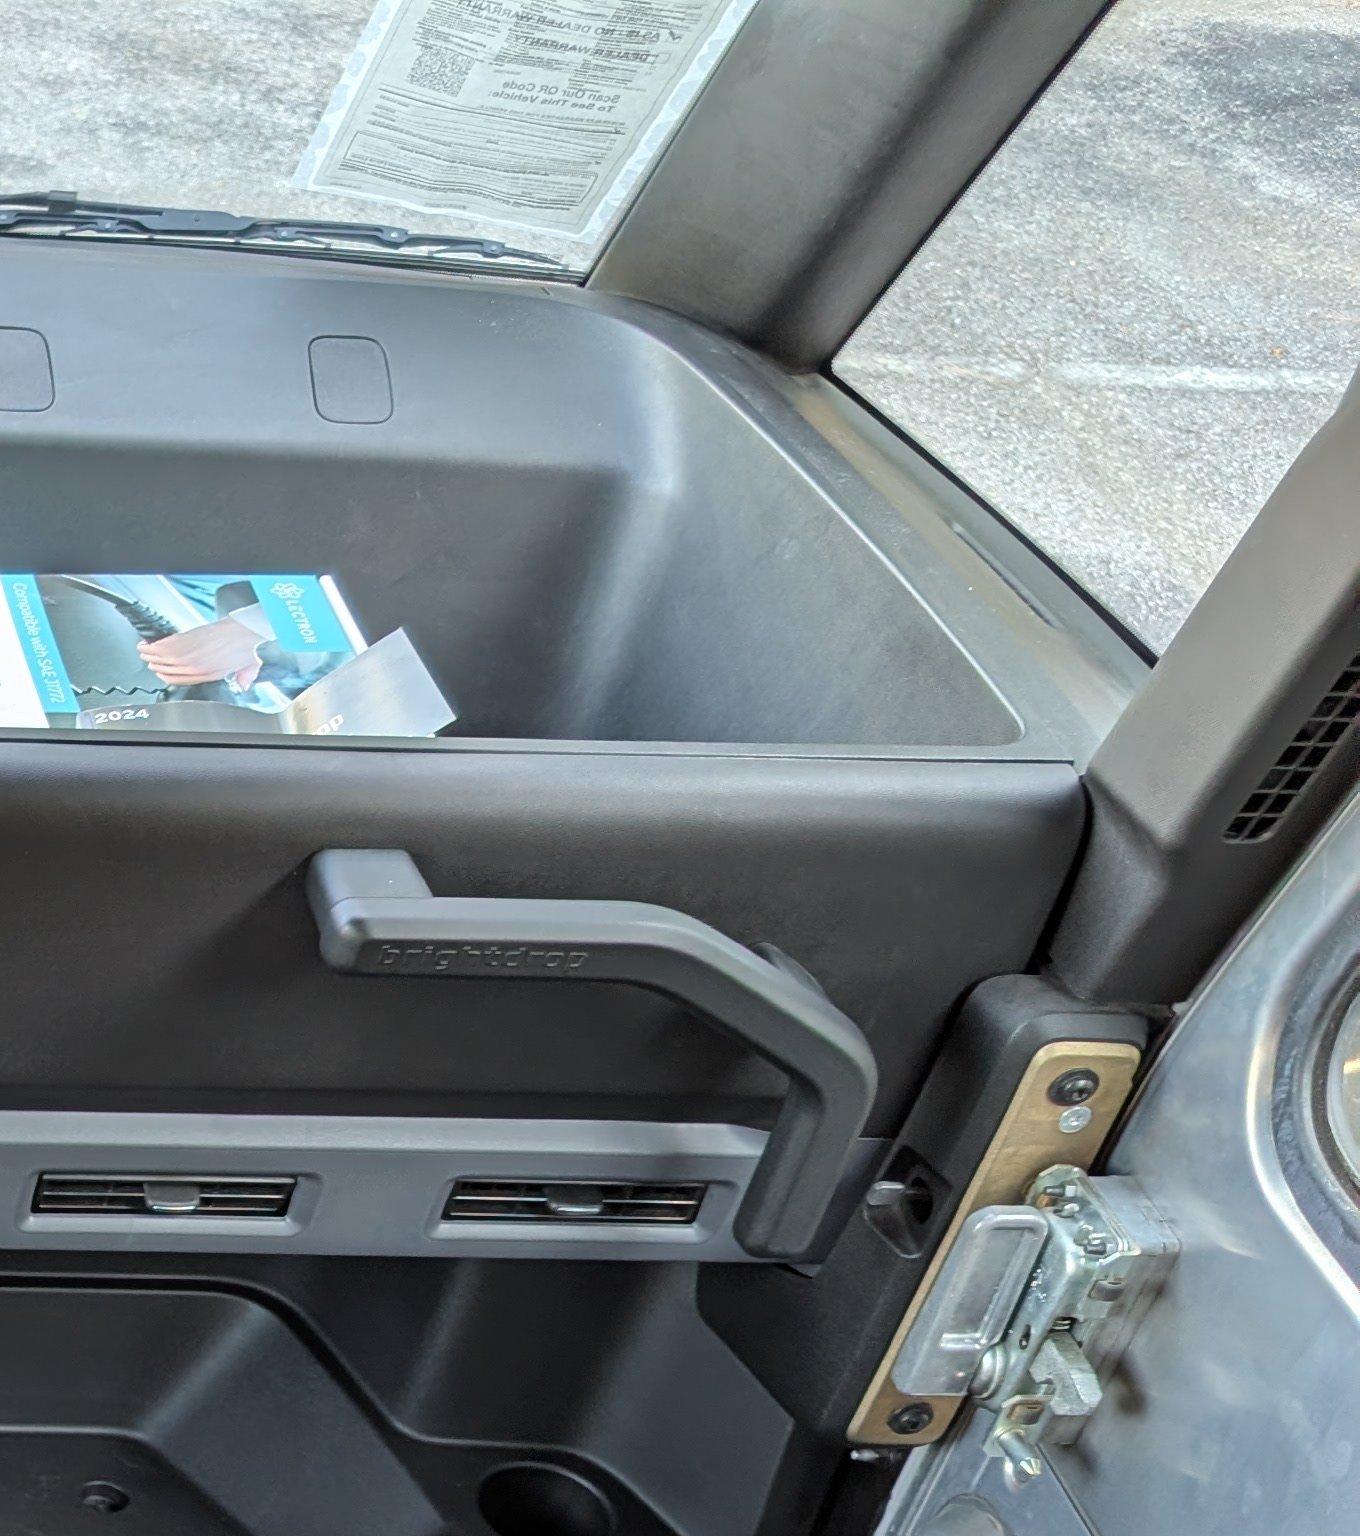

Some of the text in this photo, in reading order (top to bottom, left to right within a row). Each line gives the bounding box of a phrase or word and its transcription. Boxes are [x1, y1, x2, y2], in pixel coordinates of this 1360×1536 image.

[12, 582, 40, 637] Compatible
[30, 634, 49, 660] with
[37, 658, 57, 679] SAE
[95, 708, 150, 725] 2024
[381, 944, 589, 974] brightdrop
